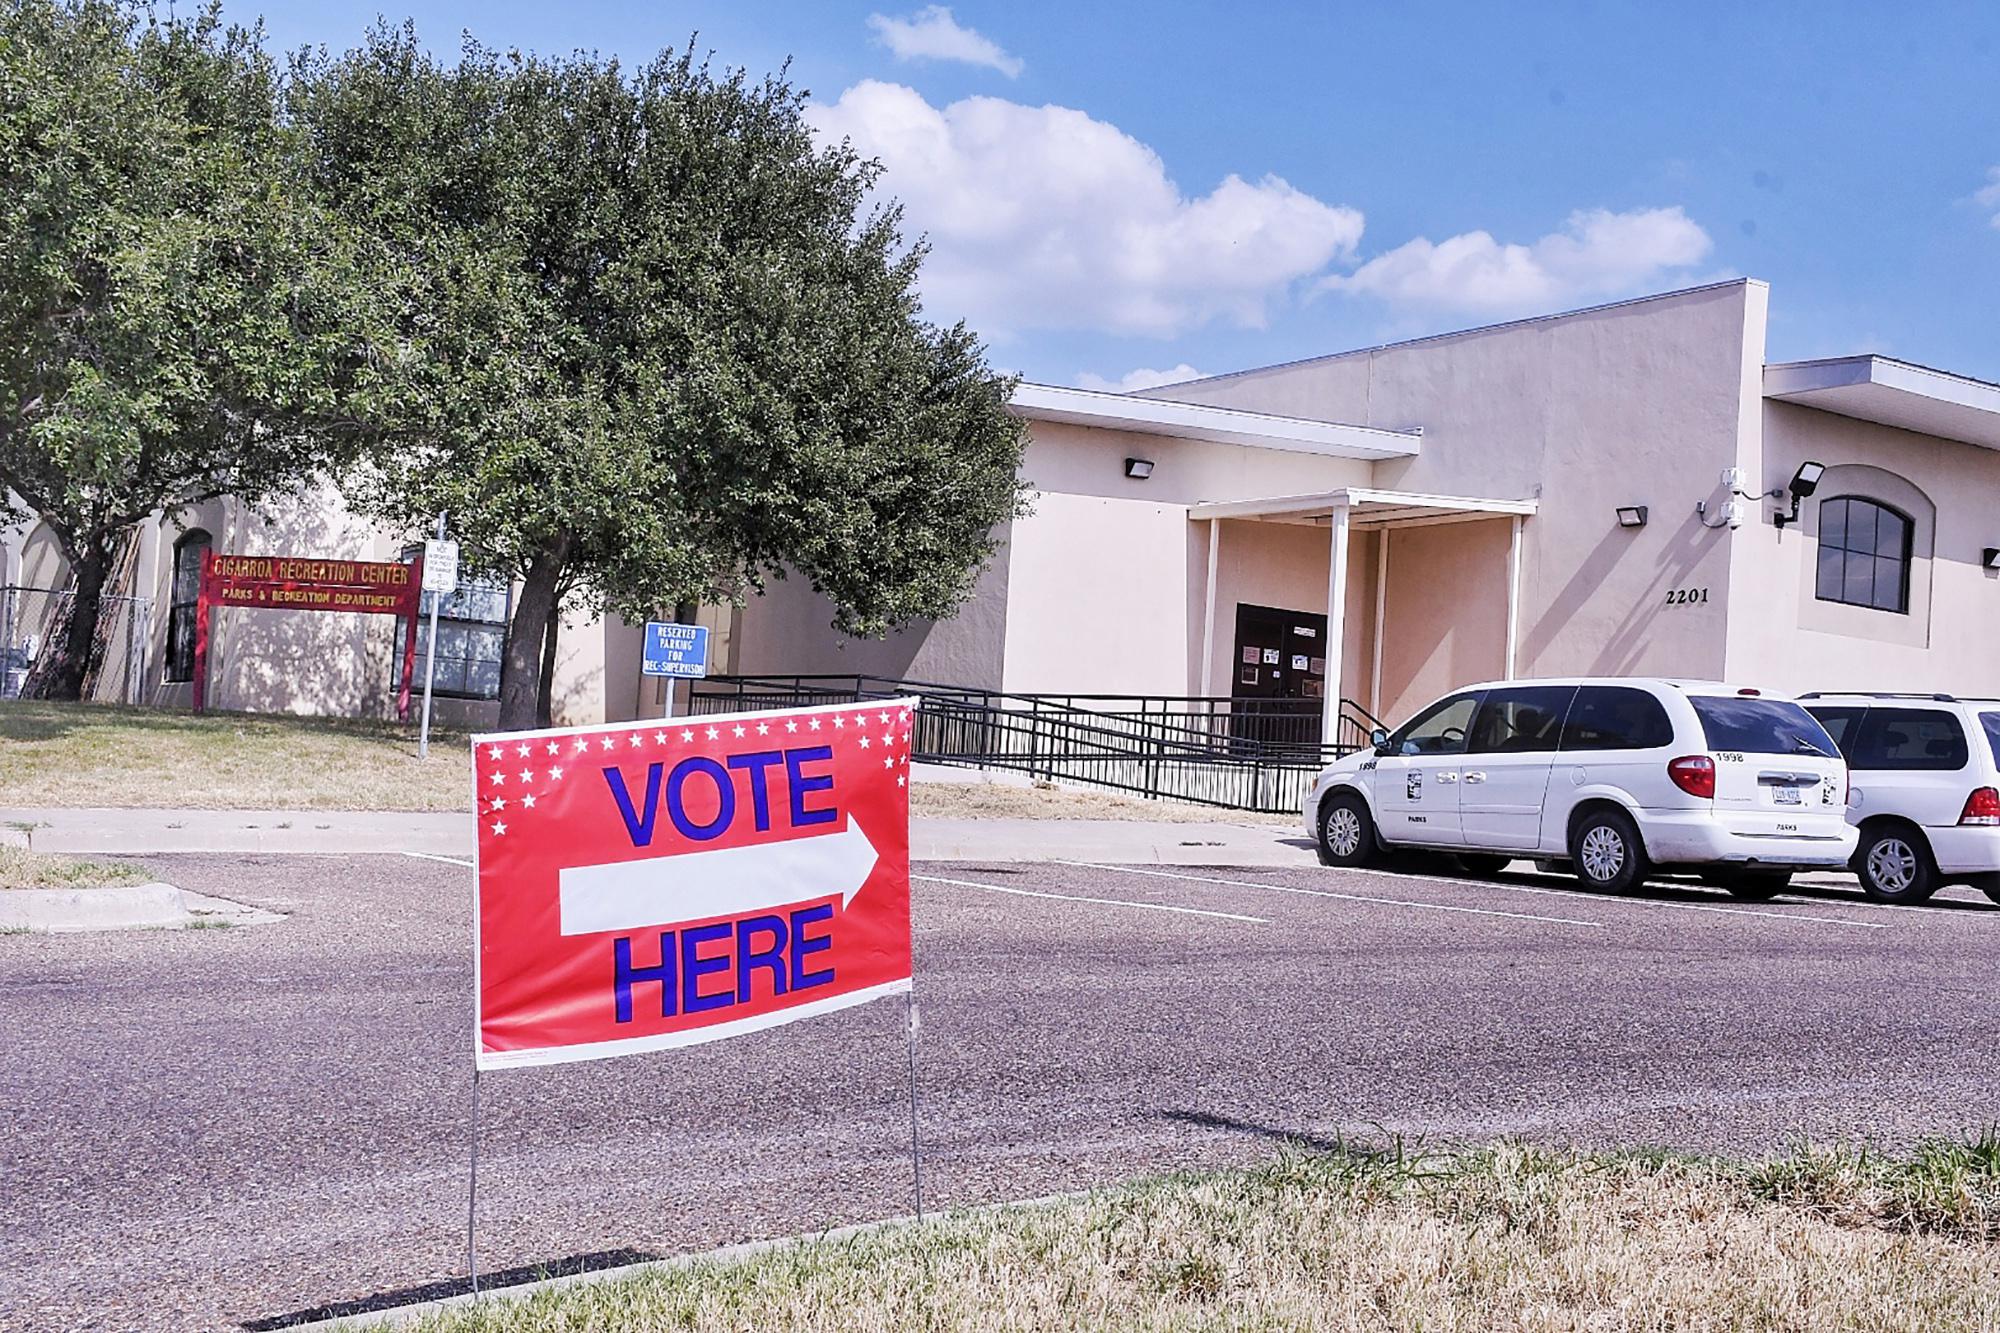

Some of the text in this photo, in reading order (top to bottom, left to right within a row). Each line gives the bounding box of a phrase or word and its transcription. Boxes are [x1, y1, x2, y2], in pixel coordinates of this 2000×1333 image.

[214, 559, 409, 585] CIGARROA RECREATION CENTER
[222, 588, 397, 607] PARKS & RECREATION DEPARTMENT
[1666, 588, 1709, 605] 2201
[657, 626, 697, 640] RESERVED
[660, 638, 693, 651] PARKING
[668, 650, 684, 661] FOR
[1716, 752, 1745, 763] 1998
[602, 745, 838, 847] VOTE
[614, 903, 836, 1024] HERE
